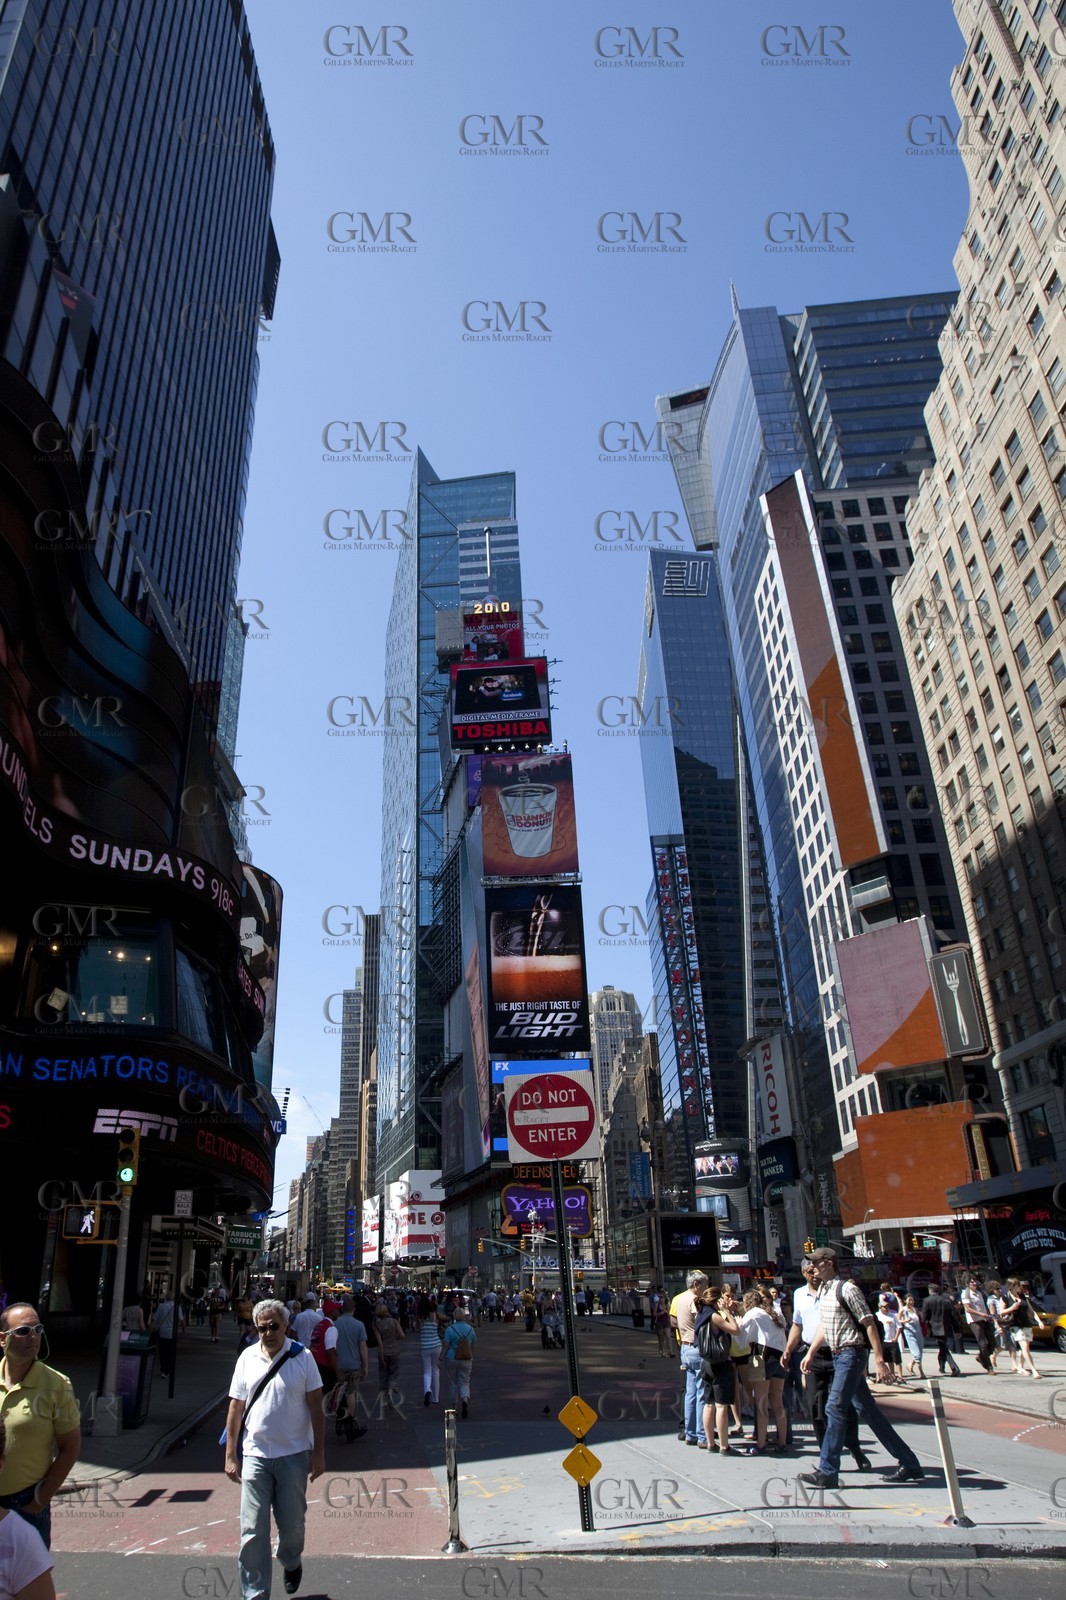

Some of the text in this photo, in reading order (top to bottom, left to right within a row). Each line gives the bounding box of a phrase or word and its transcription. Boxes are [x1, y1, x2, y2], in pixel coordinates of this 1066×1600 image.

[474, 601, 510, 614] 2010
[461, 714, 489, 722] DIGITAL
[515, 711, 540, 719] FRAME
[453, 721, 548, 739] TOSHIBA
[69, 834, 205, 890] SUNDAYS
[494, 1001, 581, 1011] THE JUST RIGHT TASTE OF
[509, 1012, 578, 1025] BUD
[494, 1025, 584, 1038] LIGHT
[495, 1062, 510, 1071] FX
[674, 1005, 700, 1117] YOUNG
[33, 1055, 169, 1083] SENATORS
[761, 1043, 781, 1134] RICOH
[522, 1089, 577, 1105] DO NOT
[93, 1108, 179, 1143] ESPN
[528, 1127, 577, 1143] ENTER
[512, 1165, 552, 1179] DEFENS
[764, 1164, 784, 1177] BANKER
[770, 1187, 783, 1196] CHAS
[506, 1195, 585, 1212] YAHO!
[227, 1230, 261, 1239] TARBUCKS
[229, 1238, 254, 1246] COFFEE
[1023, 1238, 1039, 1251] FEED
